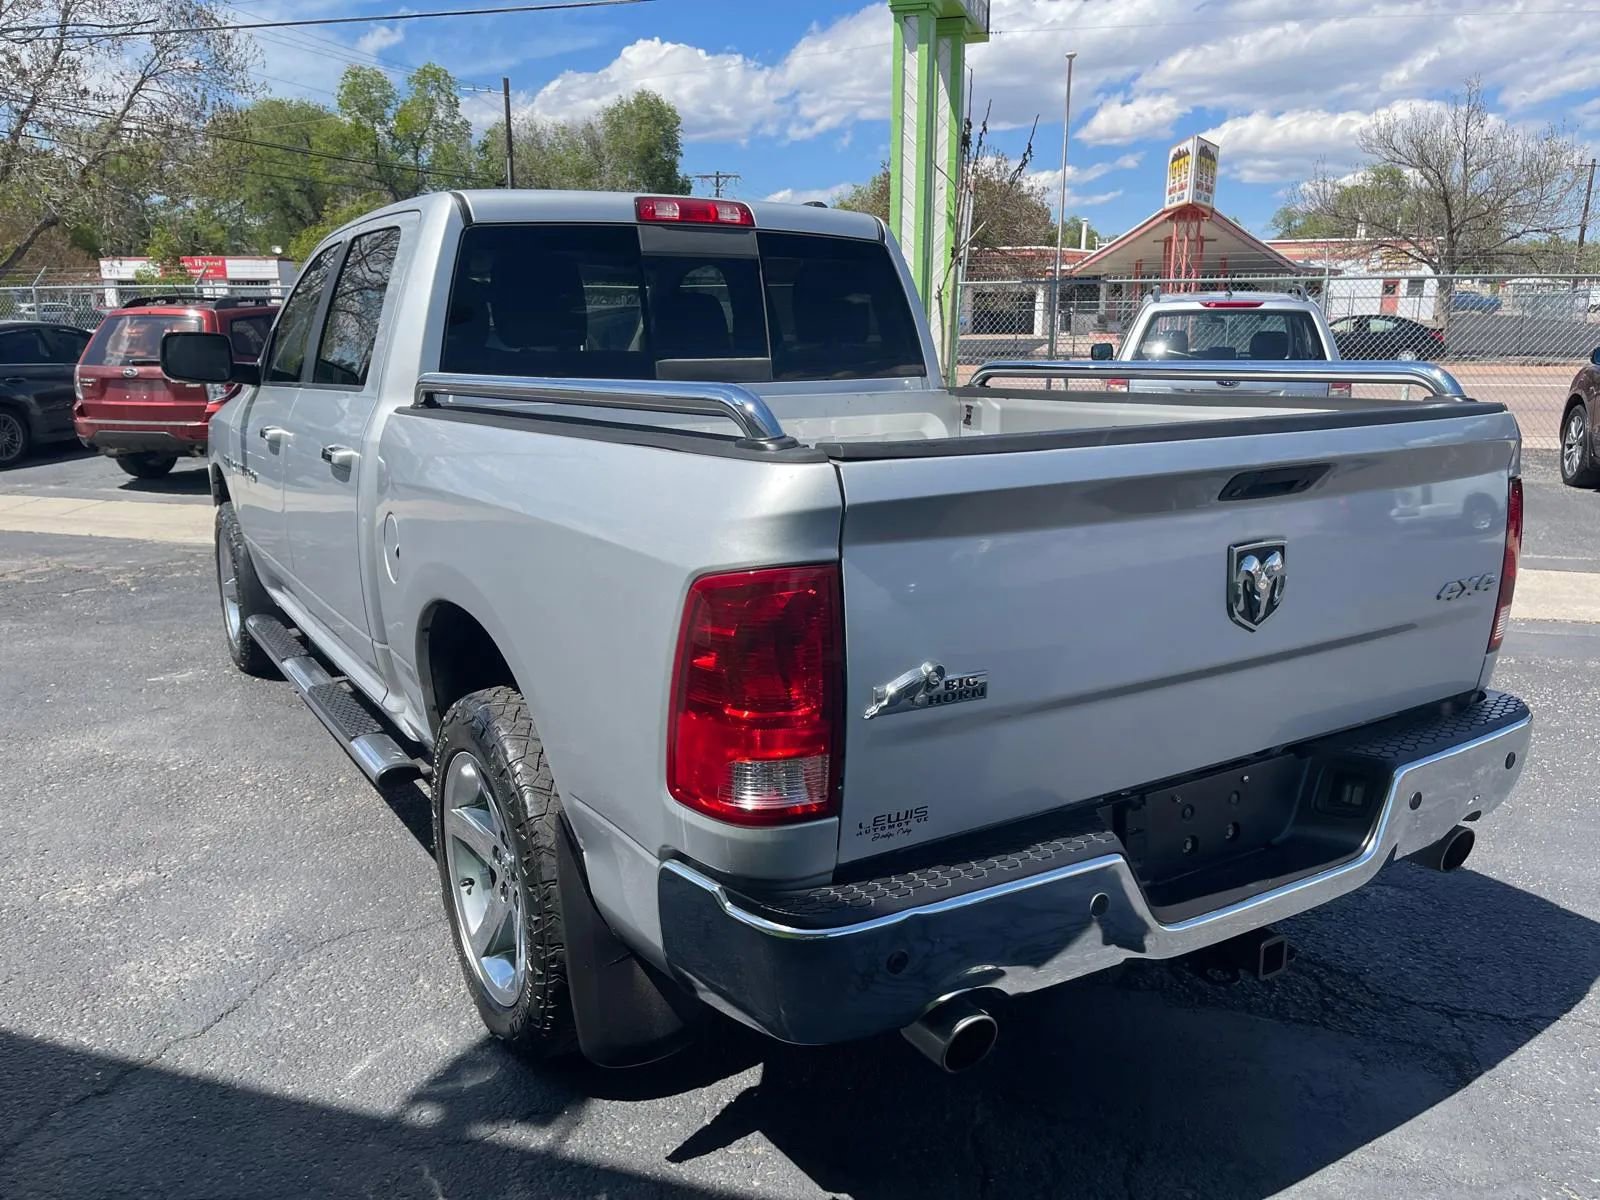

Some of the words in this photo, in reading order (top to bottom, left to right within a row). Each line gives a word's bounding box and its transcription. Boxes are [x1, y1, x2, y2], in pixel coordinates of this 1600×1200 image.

[944, 676, 978, 691] BIG
[928, 687, 986, 706] HORN
[856, 816, 929, 837] AUTOMOTVE
[858, 805, 929, 831] LEWIS
